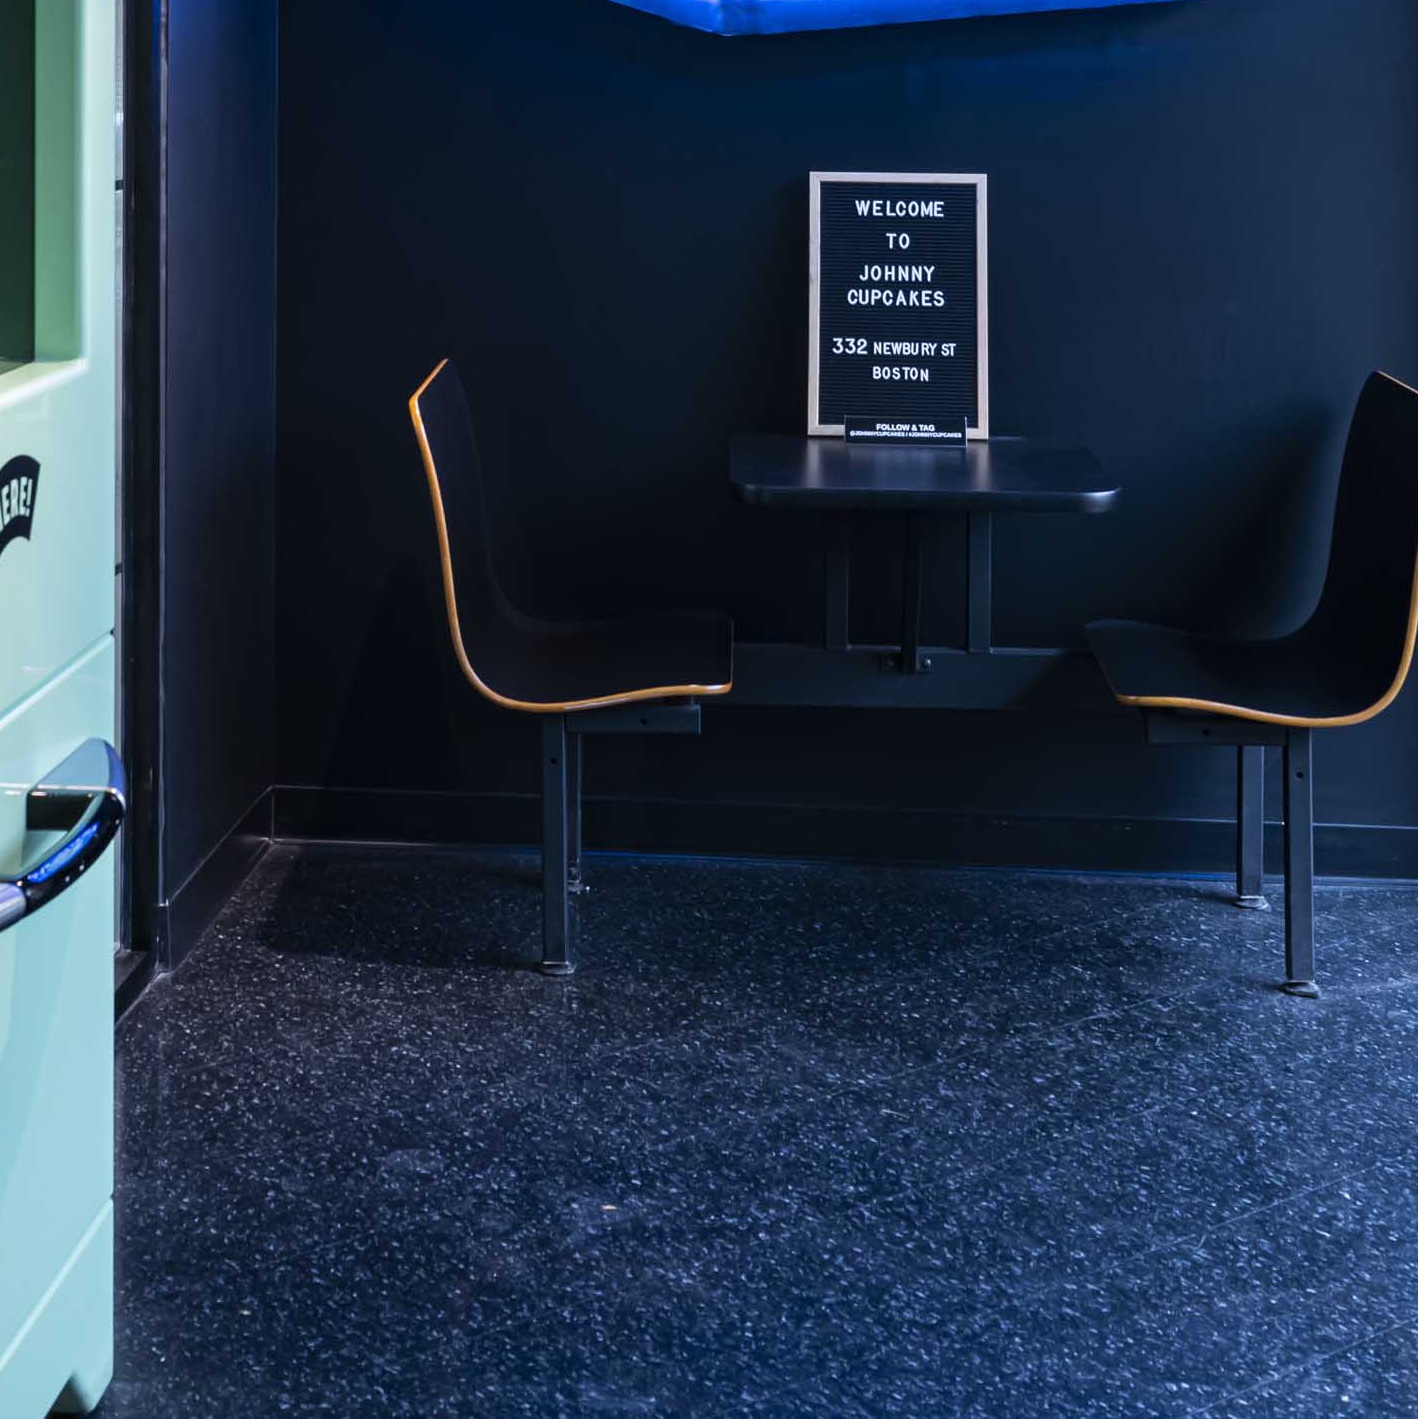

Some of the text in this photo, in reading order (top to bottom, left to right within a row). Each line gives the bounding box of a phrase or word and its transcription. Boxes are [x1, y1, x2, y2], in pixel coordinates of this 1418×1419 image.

[854, 199, 945, 218] WELCOME
[885, 232, 910, 250] TO
[858, 264, 935, 282] JOHNNY
[846, 288, 945, 307] CUPCAKES
[832, 337, 956, 357] 332 NEWBURY ST
[872, 365, 929, 383] BOSTON
[876, 423, 910, 431] FOLLOW
[919, 424, 935, 432] TAG
